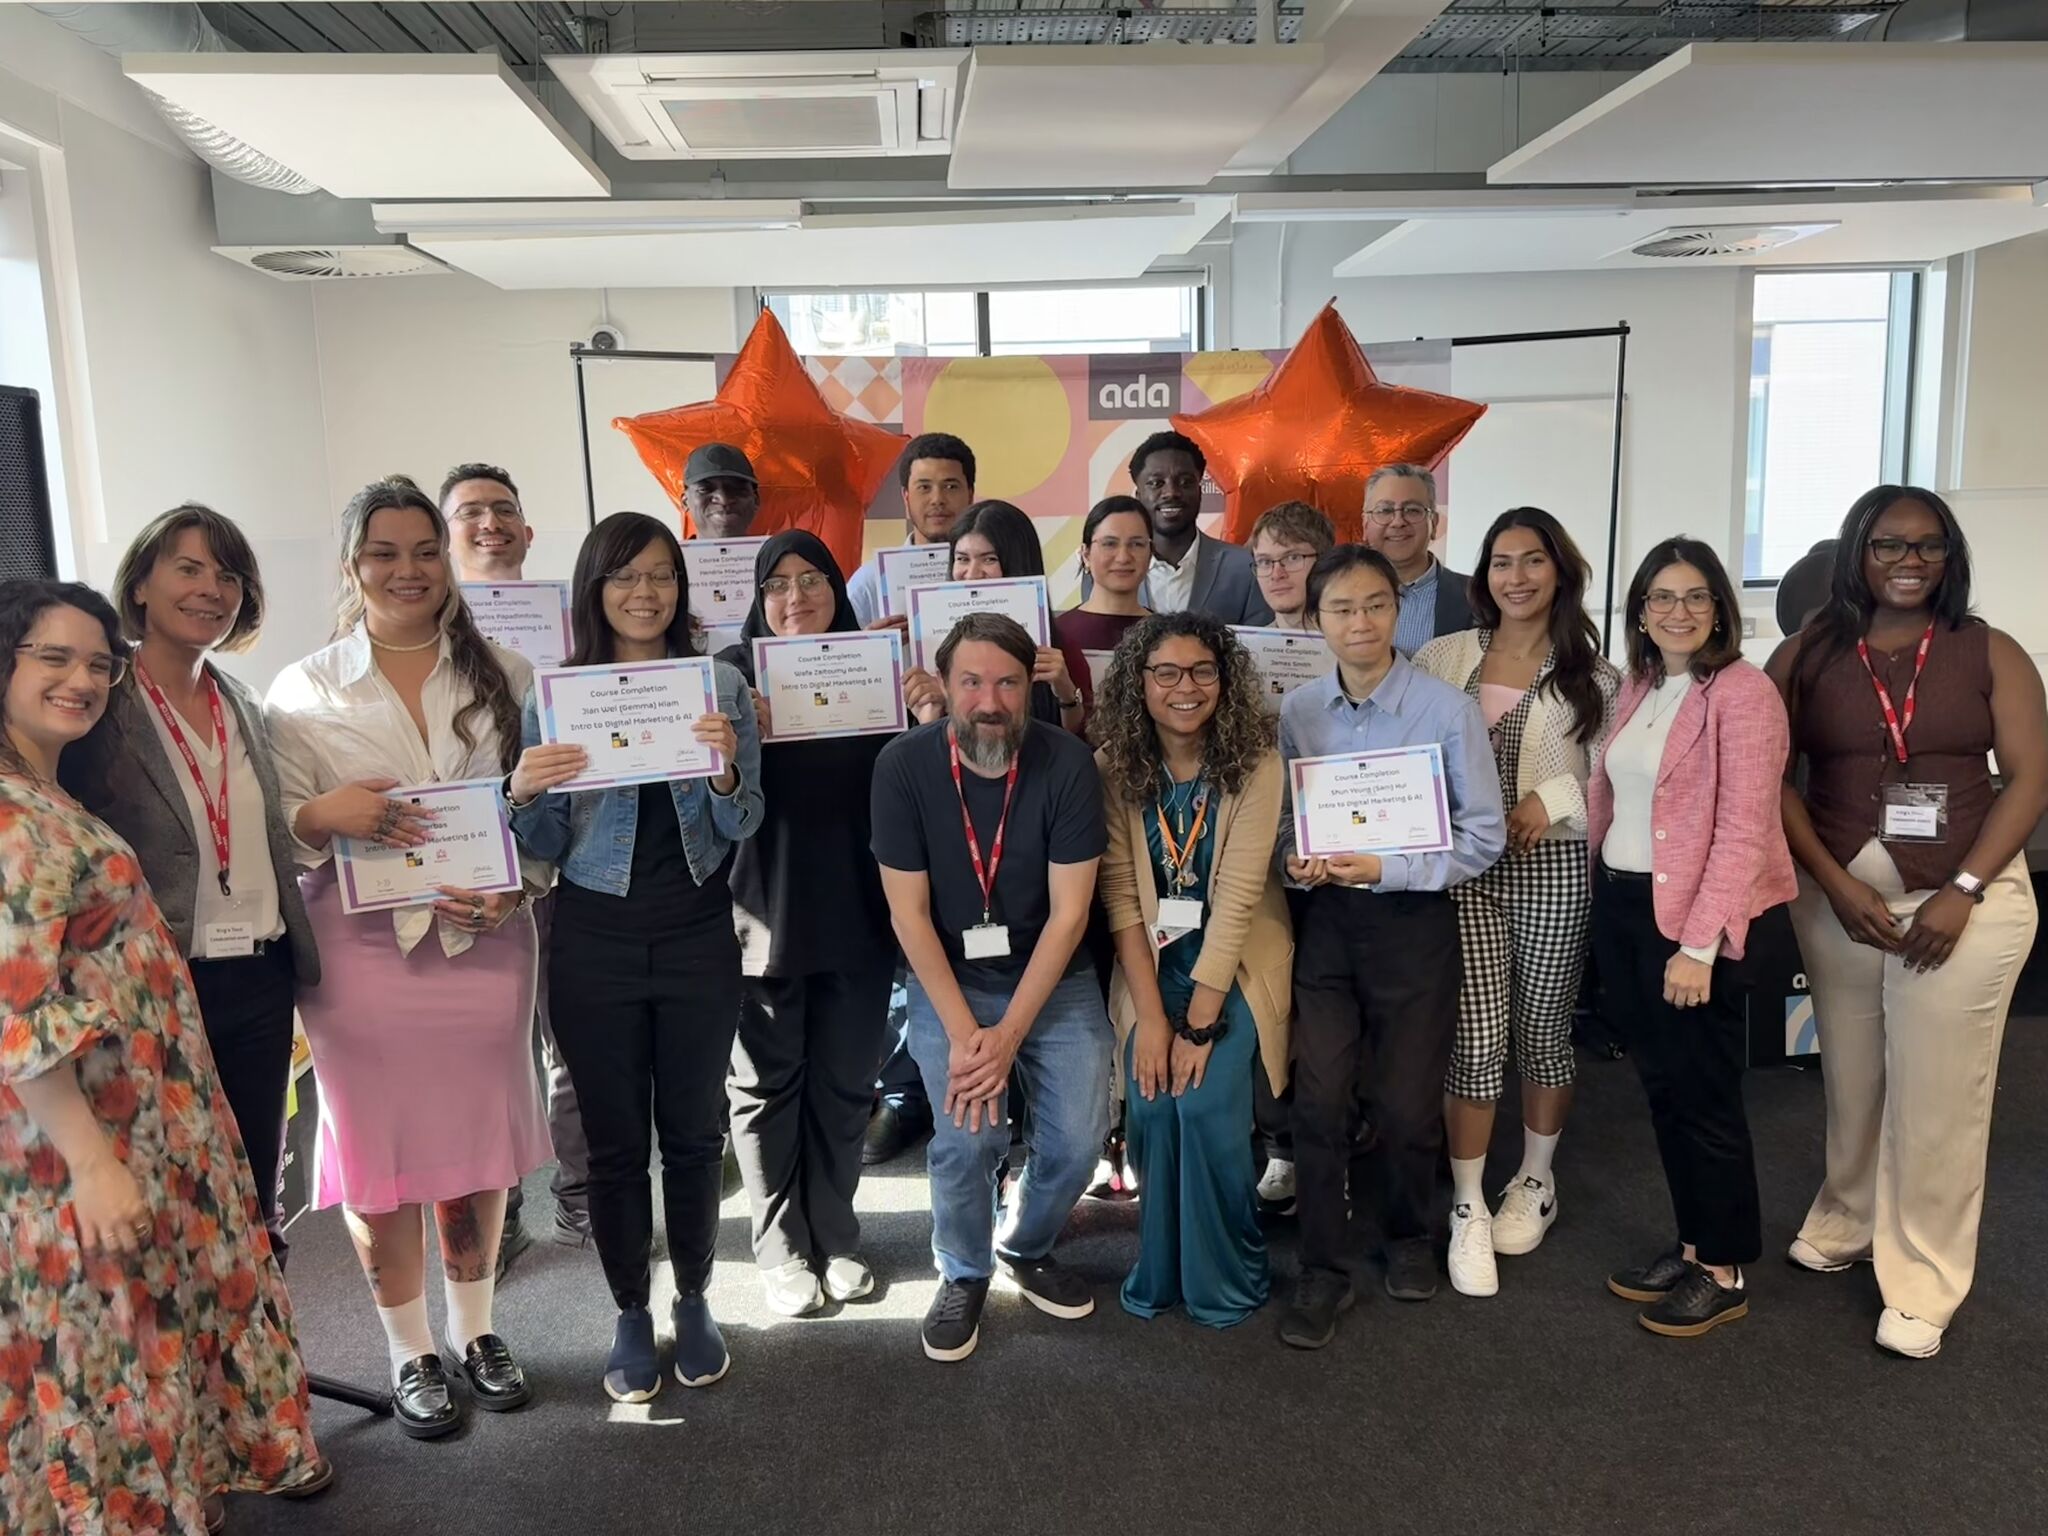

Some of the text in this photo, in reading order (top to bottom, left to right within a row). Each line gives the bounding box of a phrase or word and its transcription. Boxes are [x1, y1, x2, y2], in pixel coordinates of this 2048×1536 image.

[1099, 374, 1170, 408] ada
[1199, 480, 1225, 496] kills,
[948, 597, 1009, 608] Course Completion
[797, 652, 862, 663] Course Completion
[590, 684, 668, 698] Course Completion
[781, 683, 799, 692] Intro
[800, 682, 808, 690] to
[809, 680, 832, 690] Digital
[832, 677, 867, 687] Marketing
[601, 704, 618, 713] Wei
[619, 700, 657, 713] (Gemma)
[570, 723, 592, 731] Intro
[594, 721, 603, 729] to
[605, 718, 632, 729] Digital
[633, 713, 674, 724] Marketing
[683, 712, 693, 720] AI
[1334, 769, 1401, 782] Course Completion
[1347, 798, 1370, 808] Digital
[1370, 794, 1406, 804] Marketing
[427, 832, 468, 843] Marketing
[478, 830, 488, 838] AI
